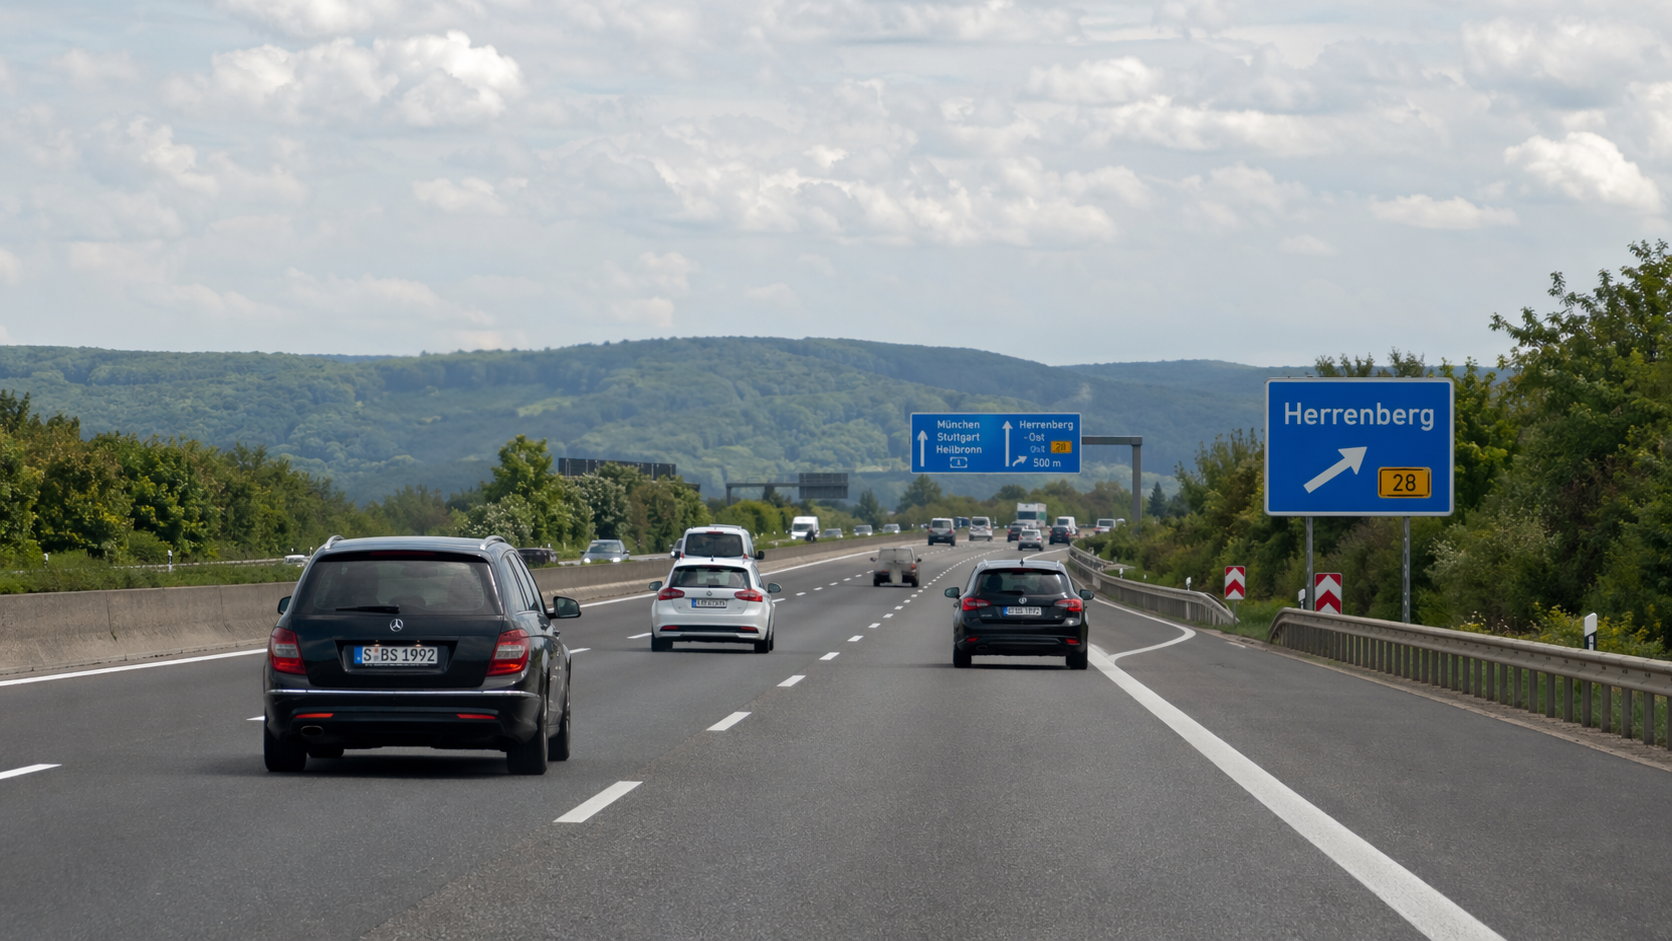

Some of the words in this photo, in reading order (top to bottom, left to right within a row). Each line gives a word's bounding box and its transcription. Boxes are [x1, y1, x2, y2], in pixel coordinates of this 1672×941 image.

[1285, 402, 1434, 431] Herrenberg
[937, 420, 980, 429] München
[1020, 420, 1073, 431] Herrenberg
[937, 432, 980, 444] Stuttgart
[936, 445, 982, 454] Heilbronn
[1033, 458, 1050, 468] 500
[1392, 473, 1417, 492] 28
[363, 648, 372, 662] S
[381, 648, 398, 662] BS
[401, 648, 435, 662] 1992
